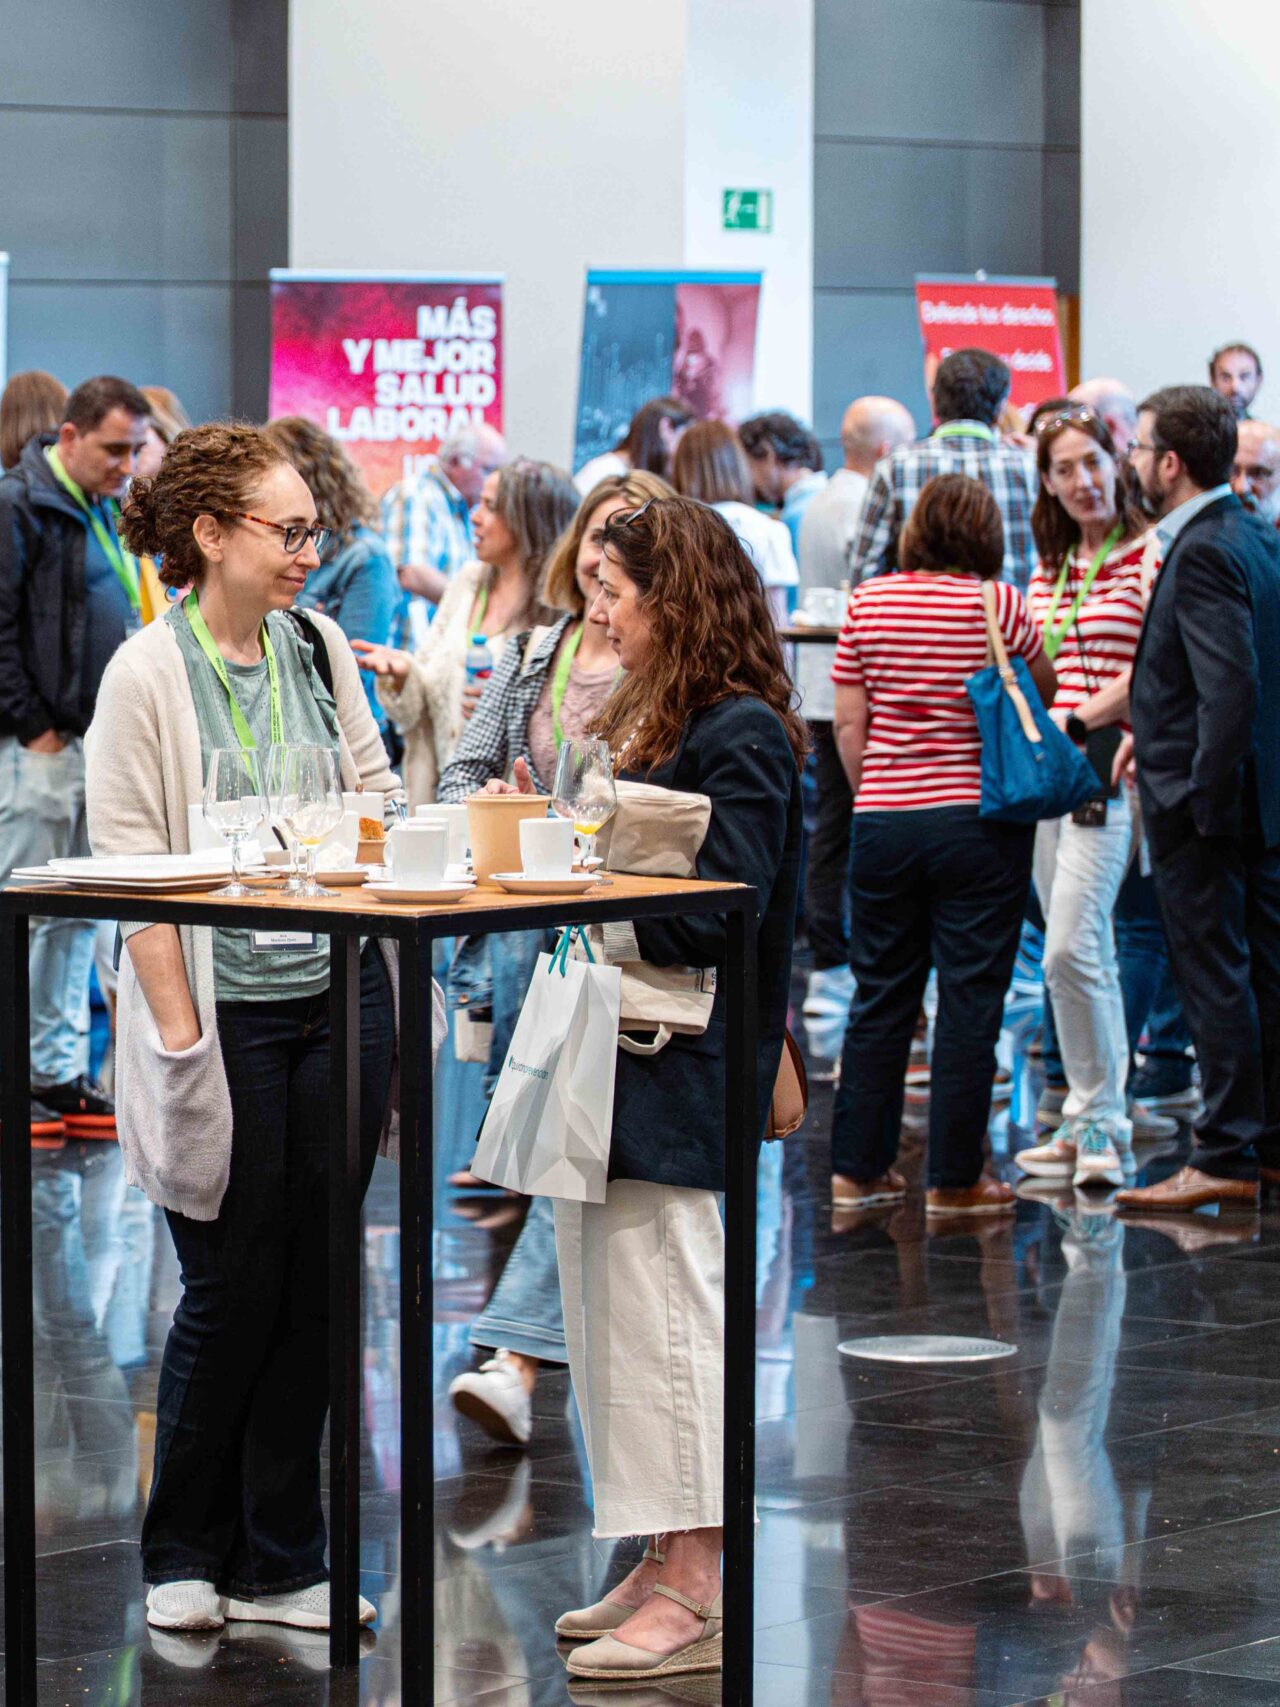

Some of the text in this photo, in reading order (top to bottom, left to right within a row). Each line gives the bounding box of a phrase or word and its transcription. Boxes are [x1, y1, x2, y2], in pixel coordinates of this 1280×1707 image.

[417, 297, 497, 340] MÁS
[342, 339, 496, 375] Y MEJOR
[374, 372, 496, 406] SALUD
